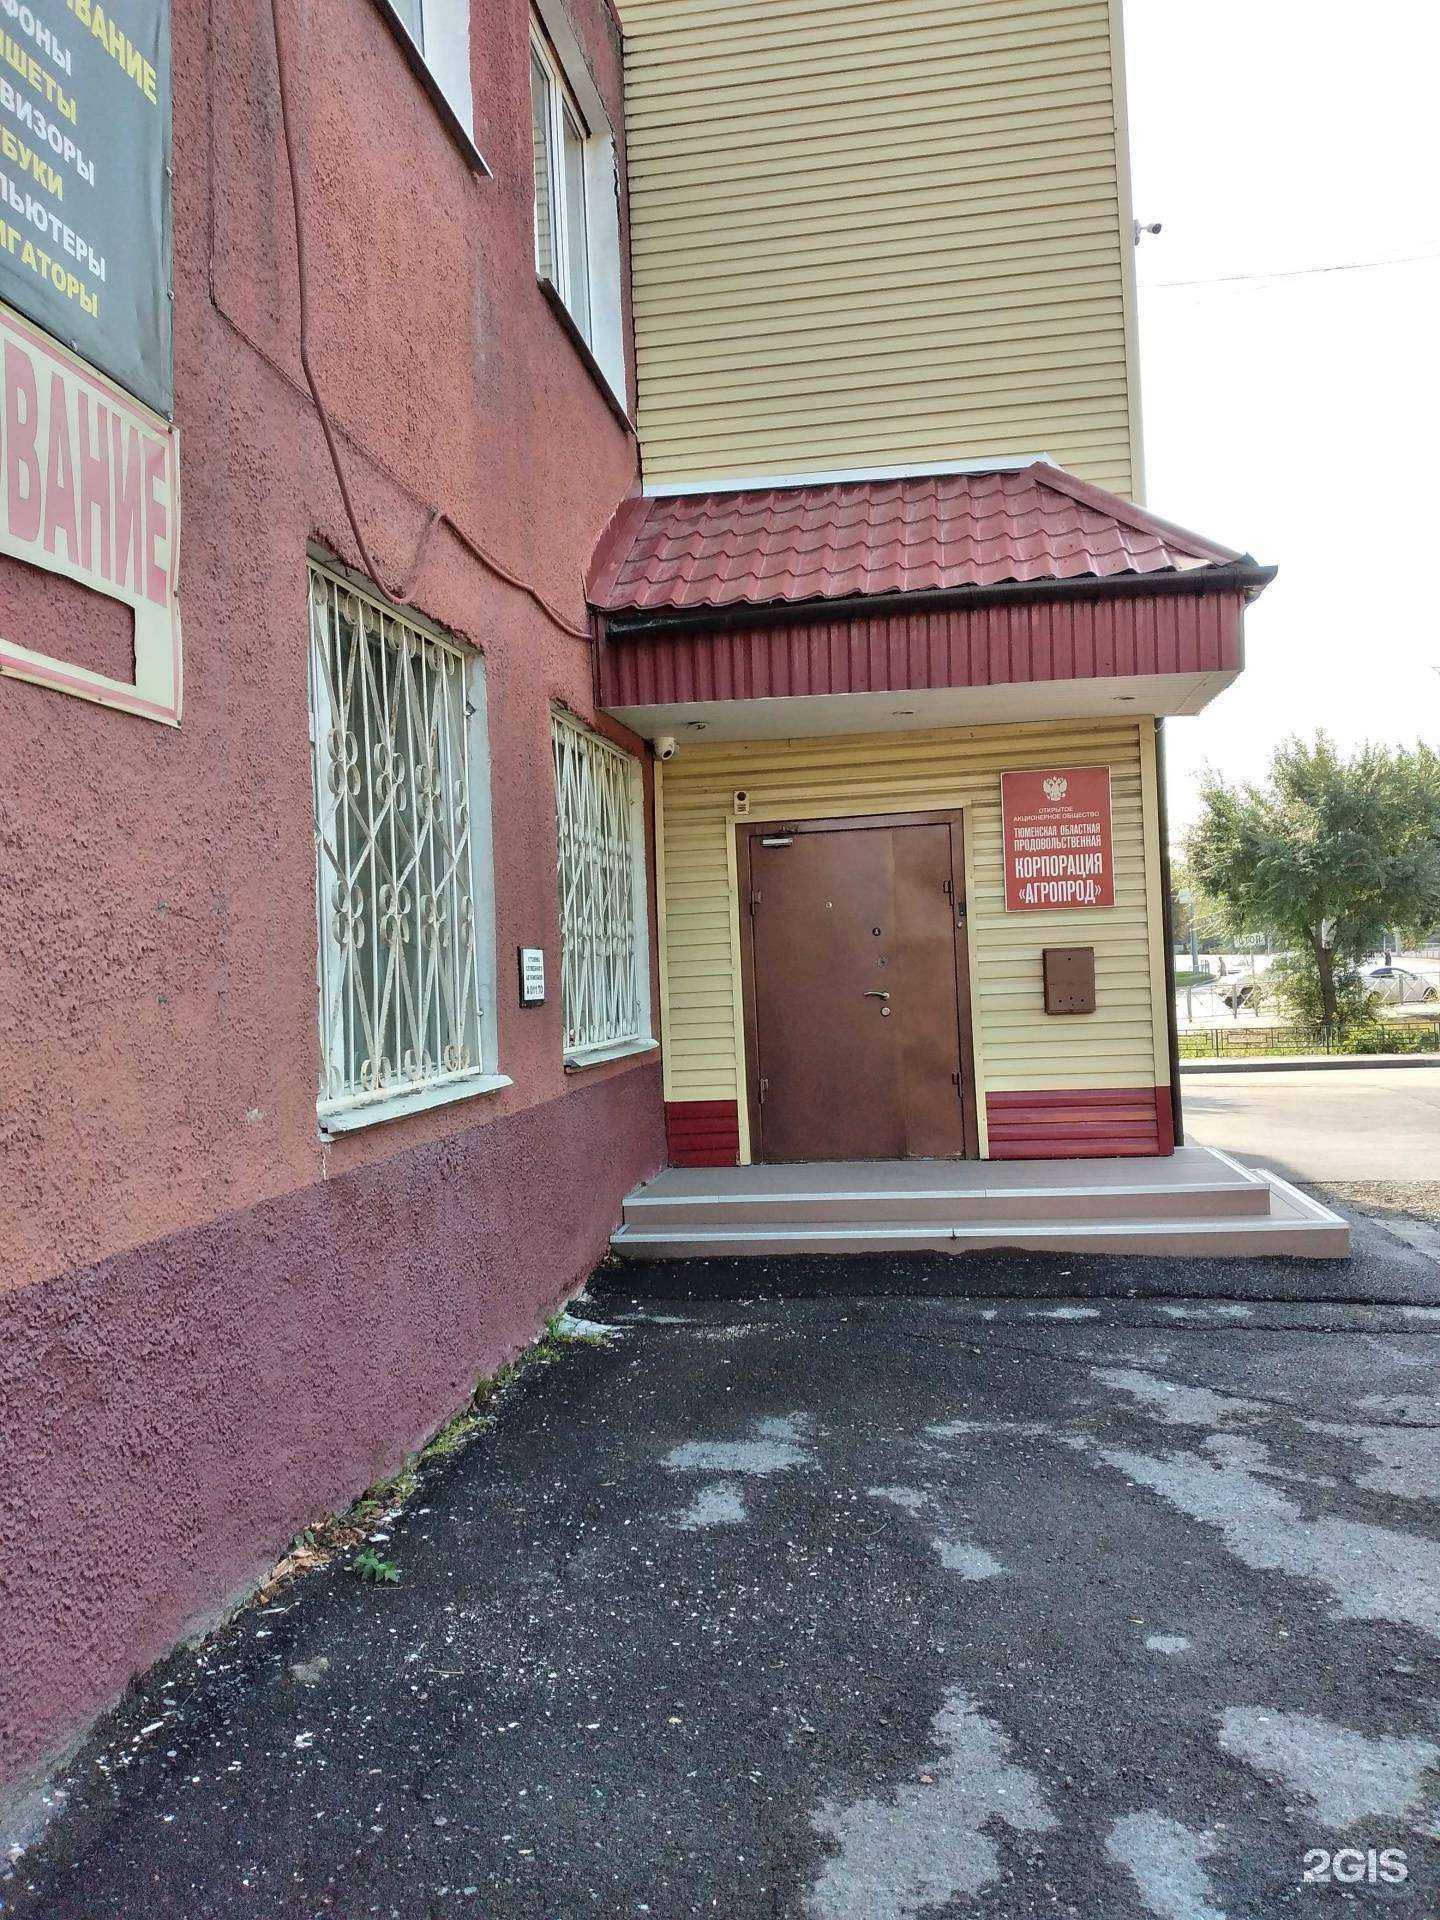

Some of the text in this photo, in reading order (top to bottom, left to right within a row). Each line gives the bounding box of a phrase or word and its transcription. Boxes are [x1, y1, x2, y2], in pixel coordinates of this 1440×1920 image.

[66, 0, 157, 105] ВАНИЕ
[0, 124, 63, 201] БУКИ
[0, 340, 167, 608] ВАНИЕ
[1013, 811, 1100, 822] АКЦИОНЕРНОЕ ОБЩЕСТВО
[1014, 823, 1100, 838] ТЮМЕНСКАЯ ОБЛАСТНАЯ
[1014, 835, 1101, 852] ПРОДОВОЛЬСТВЕННАЯ
[1015, 853, 1103, 878] КОРПОРАЦИЯ
[1018, 880, 1102, 904] «АГРОПРОД»
